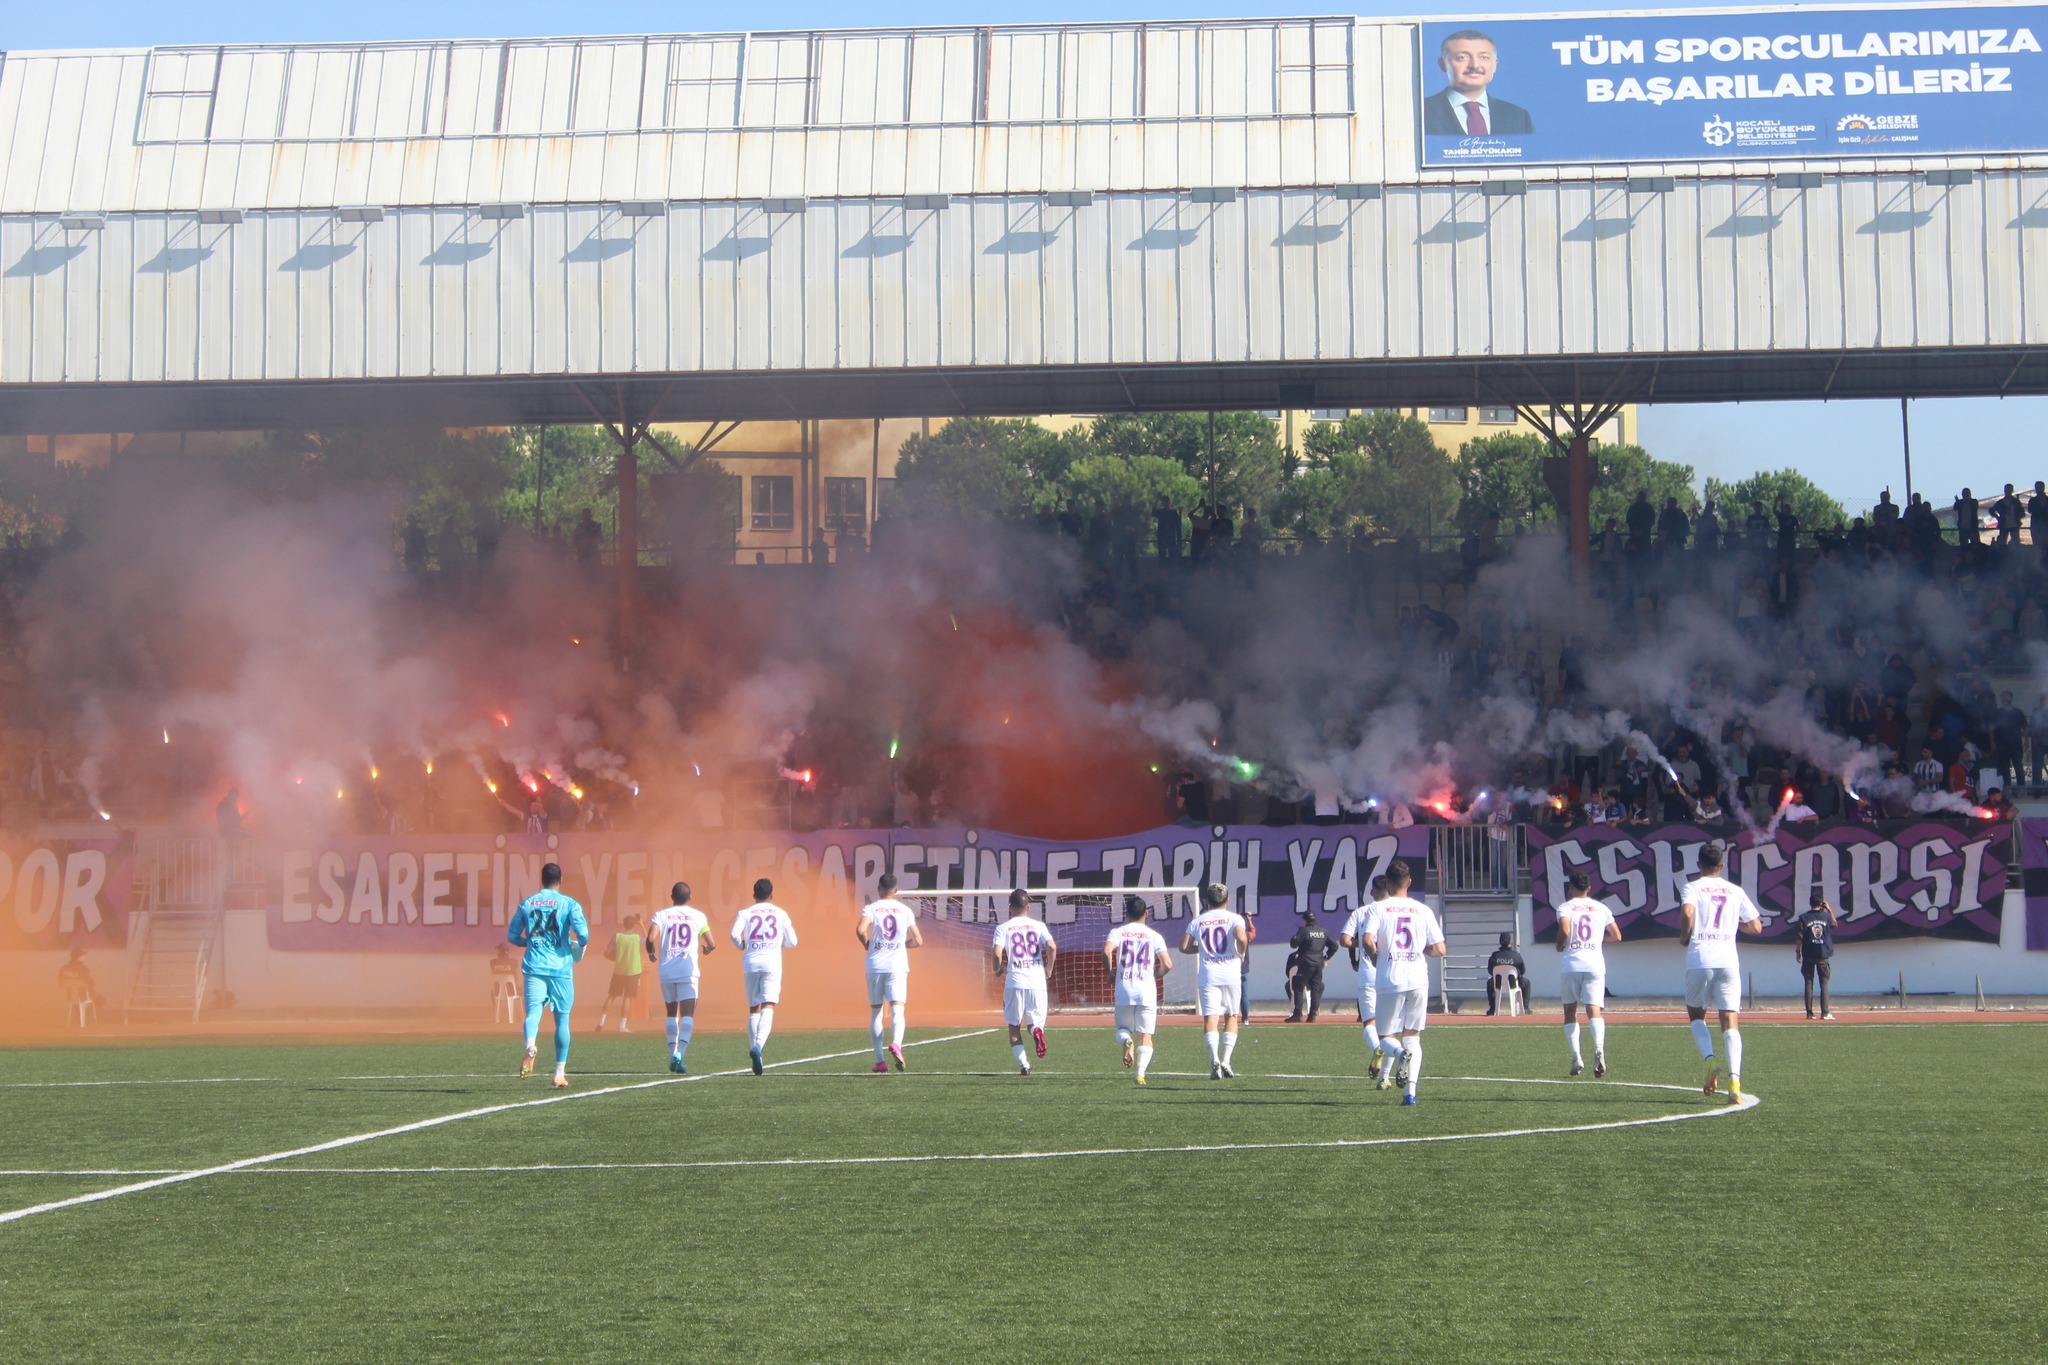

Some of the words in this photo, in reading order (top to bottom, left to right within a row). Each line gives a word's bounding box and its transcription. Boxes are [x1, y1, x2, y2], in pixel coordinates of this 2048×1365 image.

[1552, 35, 1644, 65] TÜM
[1654, 28, 2043, 63] SPORCULARIMIZA
[1586, 72, 1835, 106] BAŞARILAR
[1844, 62, 2012, 96] DİLERİZ
[1736, 119, 1781, 127] KOCAELİ
[1876, 114, 1918, 125] GEBZE
[1443, 148, 1469, 156] TAHİR
[579, 850, 686, 926] YEN
[1101, 825, 1261, 923] TARİH
[1287, 835, 1399, 914] YAZ
[0, 848, 107, 934] OR
[529, 909, 560, 937] 24
[1385, 905, 1422, 915] KOCEL
[1711, 895, 1728, 929] 7
[668, 923, 692, 949] 19
[749, 914, 778, 941] 23
[882, 913, 898, 941] 9
[1201, 926, 1228, 954] 10
[1395, 916, 1413, 950] 5
[1577, 914, 1592, 943] 6
[1010, 931, 1040, 959] 88
[1120, 939, 1151, 970] 54
[1012, 959, 1041, 969] MERT
